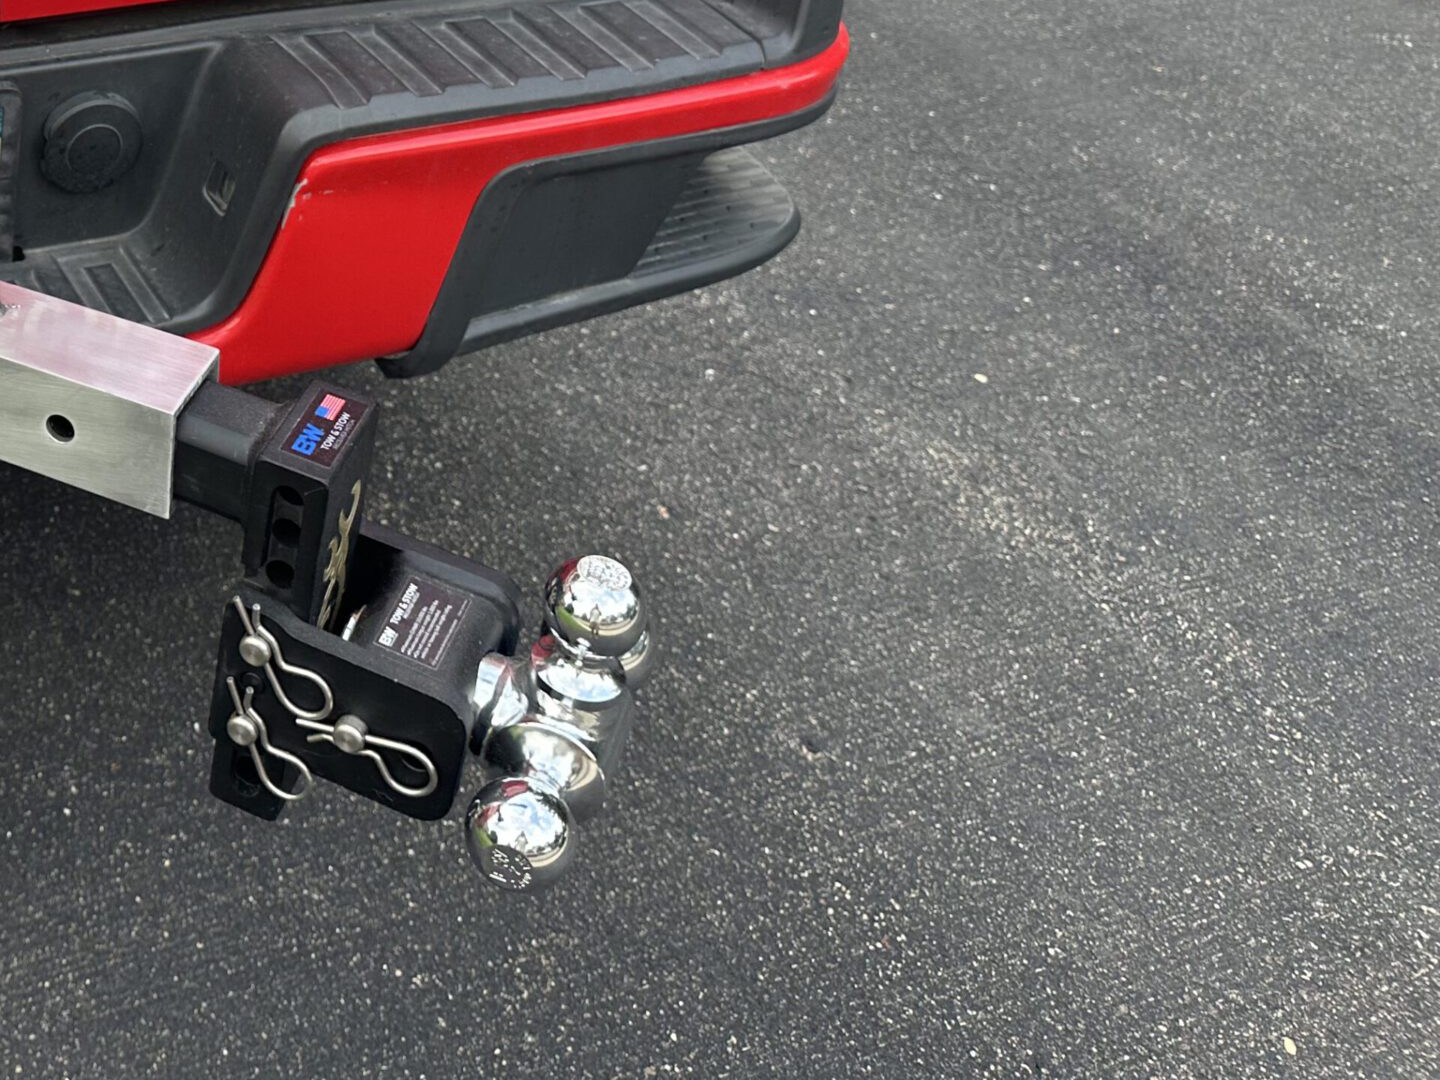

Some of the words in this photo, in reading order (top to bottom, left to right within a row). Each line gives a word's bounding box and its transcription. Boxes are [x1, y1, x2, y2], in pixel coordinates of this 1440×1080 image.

[320, 434, 335, 450] TOW
[334, 411, 351, 431] STOW
[389, 606, 404, 624] TOW
[401, 582, 418, 603] STOW
